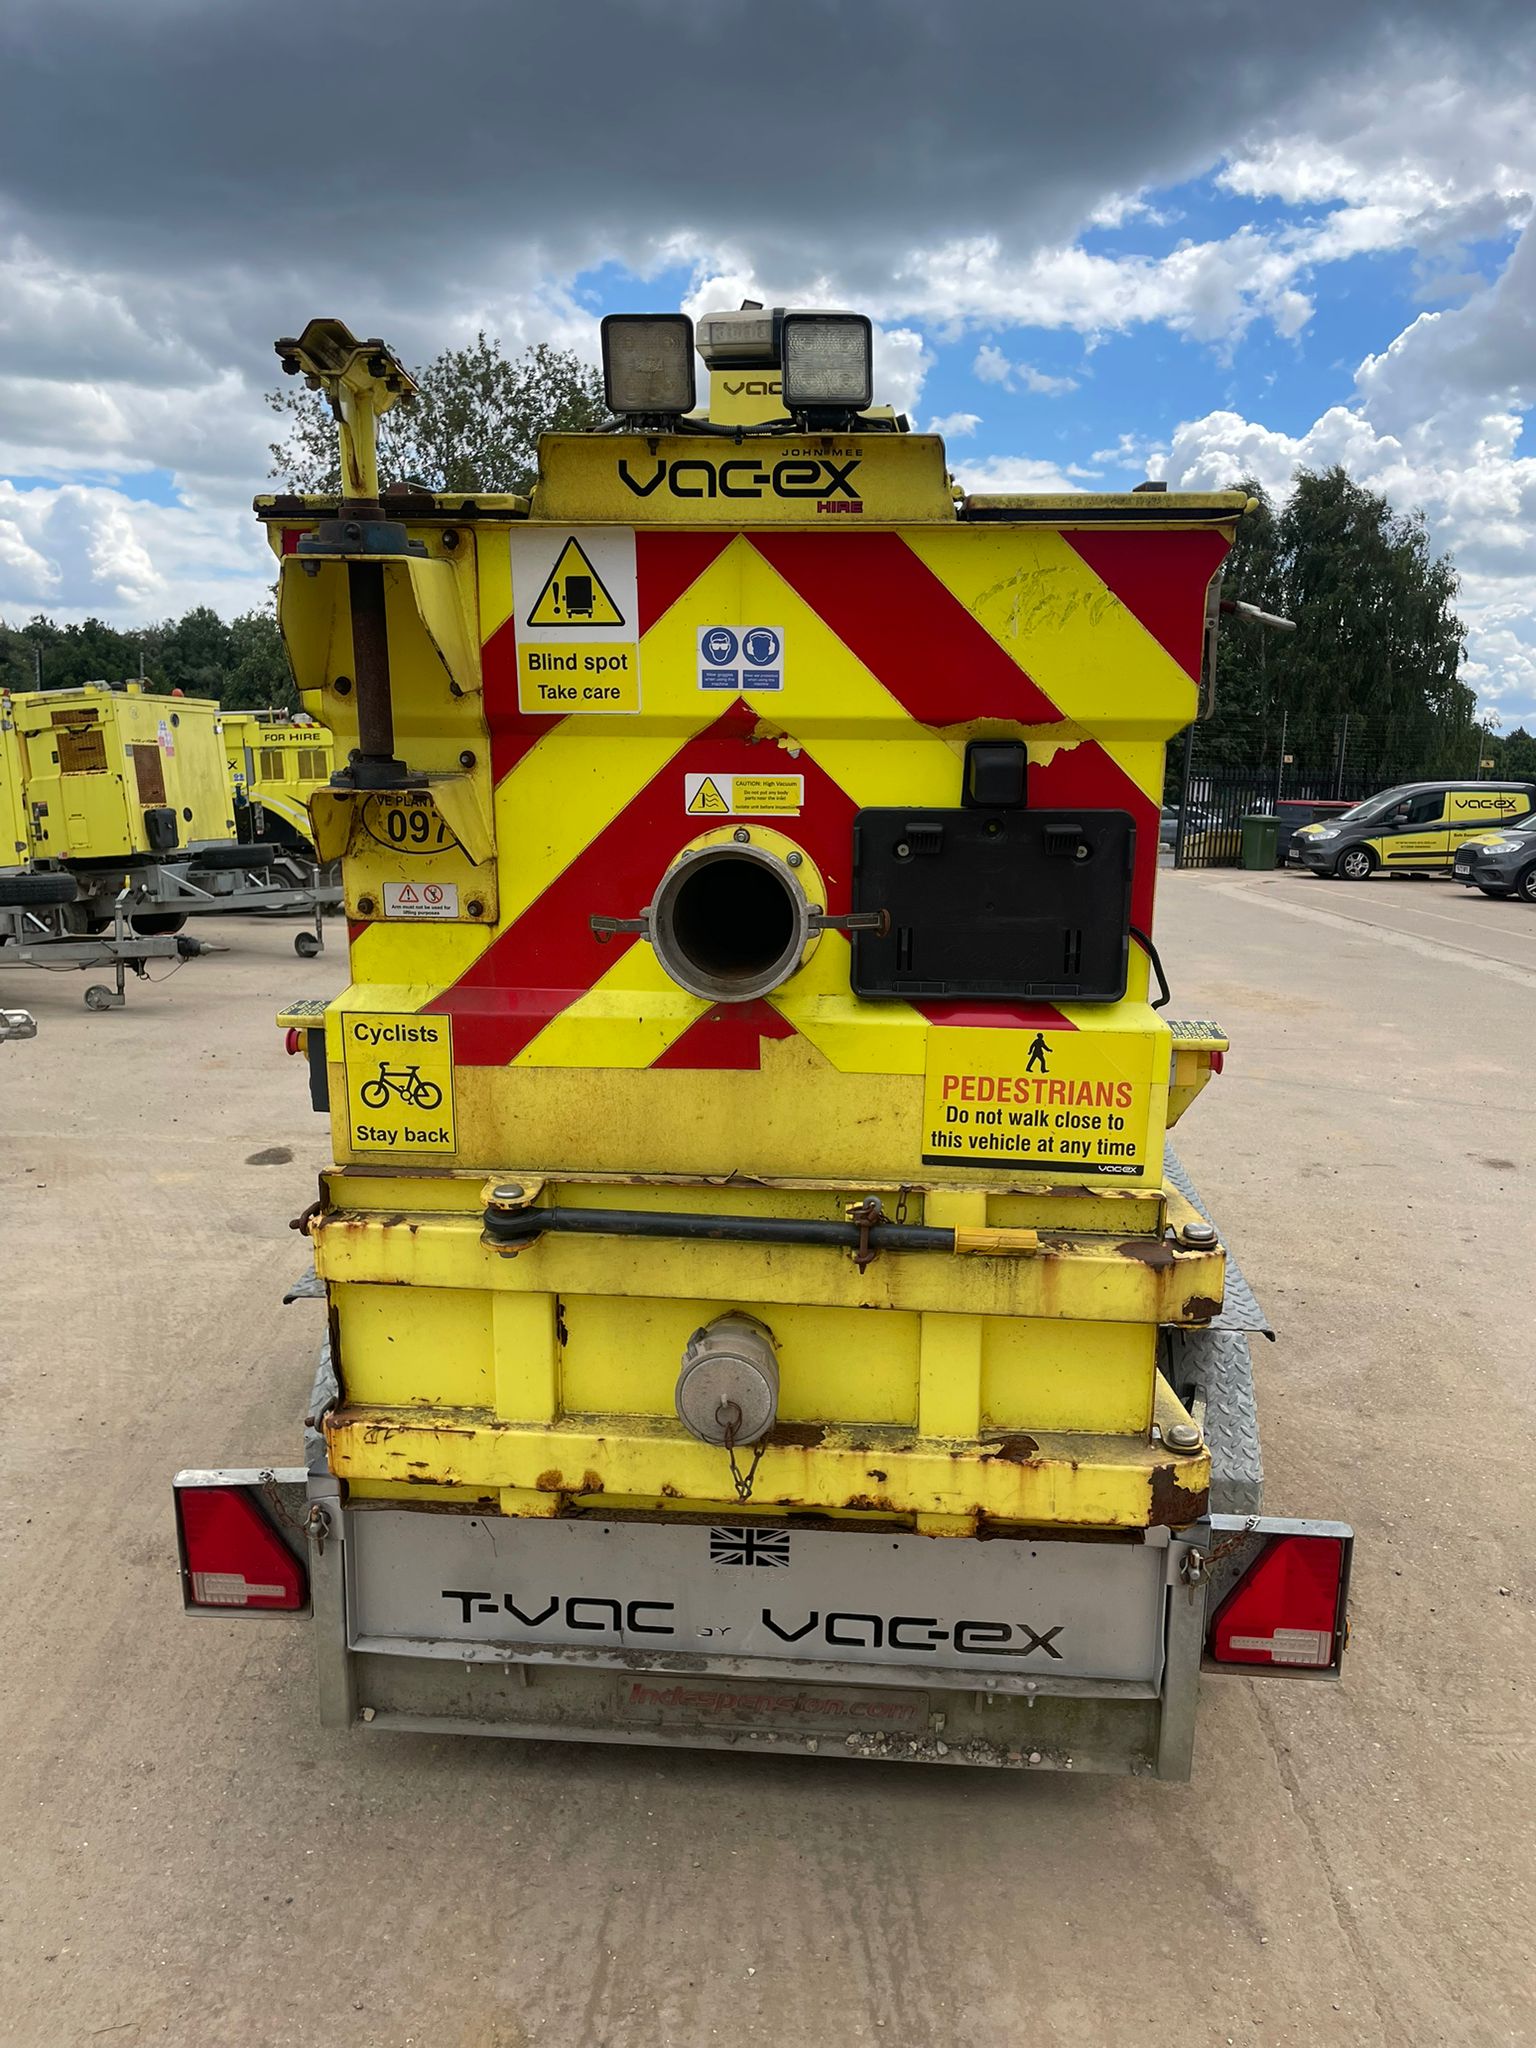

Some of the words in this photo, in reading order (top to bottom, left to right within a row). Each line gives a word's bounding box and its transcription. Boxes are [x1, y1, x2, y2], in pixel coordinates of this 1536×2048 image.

[817, 501, 863, 513] HIRE
[528, 653, 577, 670] Blind
[584, 654, 628, 674] spot
[538, 685, 577, 699] Take
[583, 688, 620, 699] care
[354, 1024, 438, 1045] Cyclists
[943, 1075, 1132, 1108] PEDESTRIANS
[946, 1106, 968, 1124] Do
[975, 1109, 1002, 1125] not
[1009, 1110, 1048, 1128] walk
[1055, 1111, 1100, 1130] close
[1108, 1114, 1124, 1130] to
[356, 1126, 398, 1144] Stay
[405, 1127, 449, 1142] back
[931, 1130, 962, 1148] this
[969, 1132, 1030, 1152] vehicle
[1038, 1136, 1054, 1152] at
[1060, 1140, 1091, 1158] any
[1098, 1138, 1136, 1156] time
[629, 1684, 917, 1719] Indespension.com
